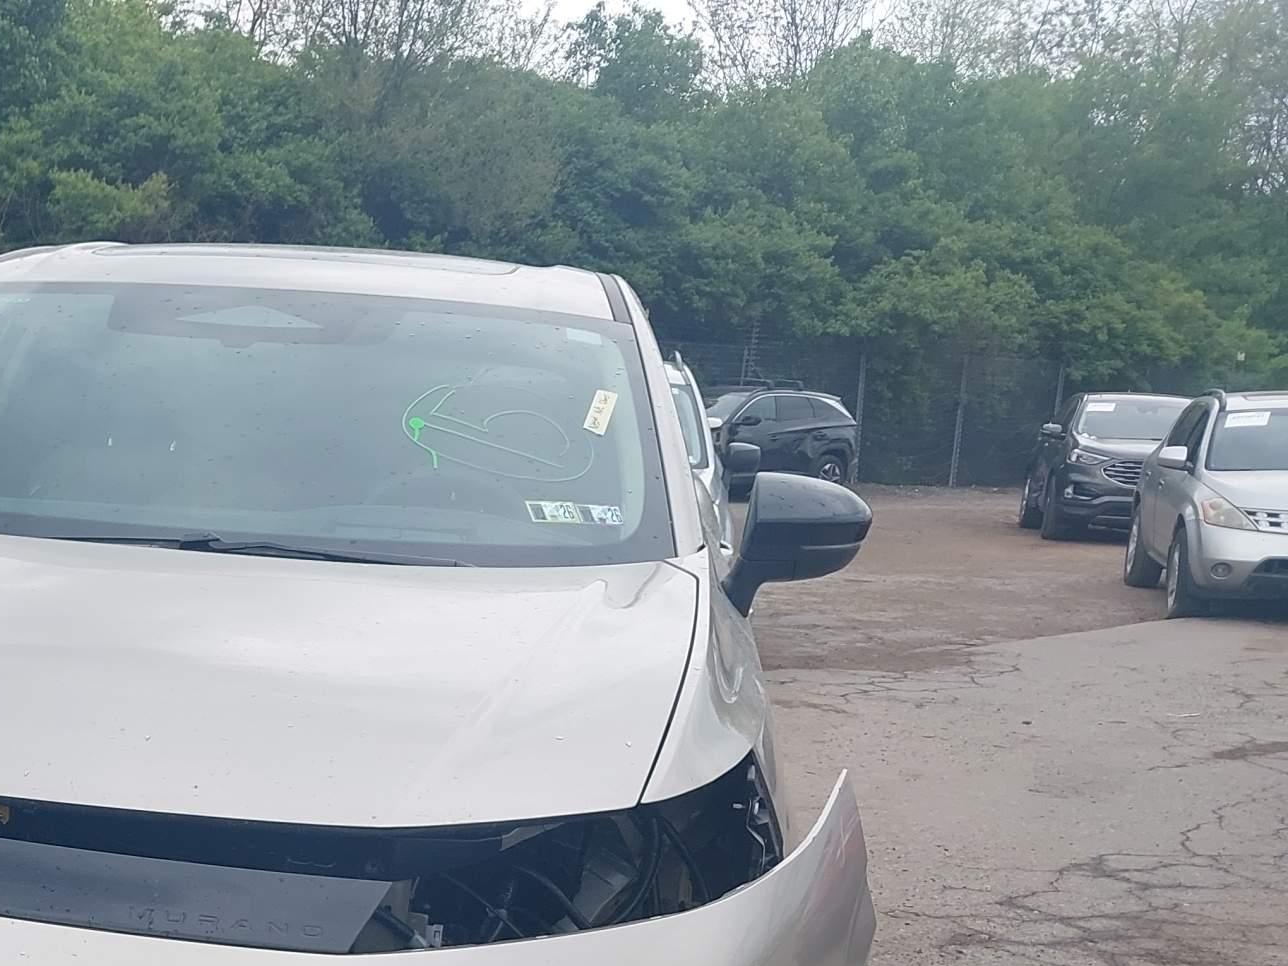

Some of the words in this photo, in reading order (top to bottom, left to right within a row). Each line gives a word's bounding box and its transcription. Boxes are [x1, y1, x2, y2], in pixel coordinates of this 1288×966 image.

[559, 504, 575, 519] 26
[607, 507, 623, 523] 26
[133, 908, 324, 937] MURANO
